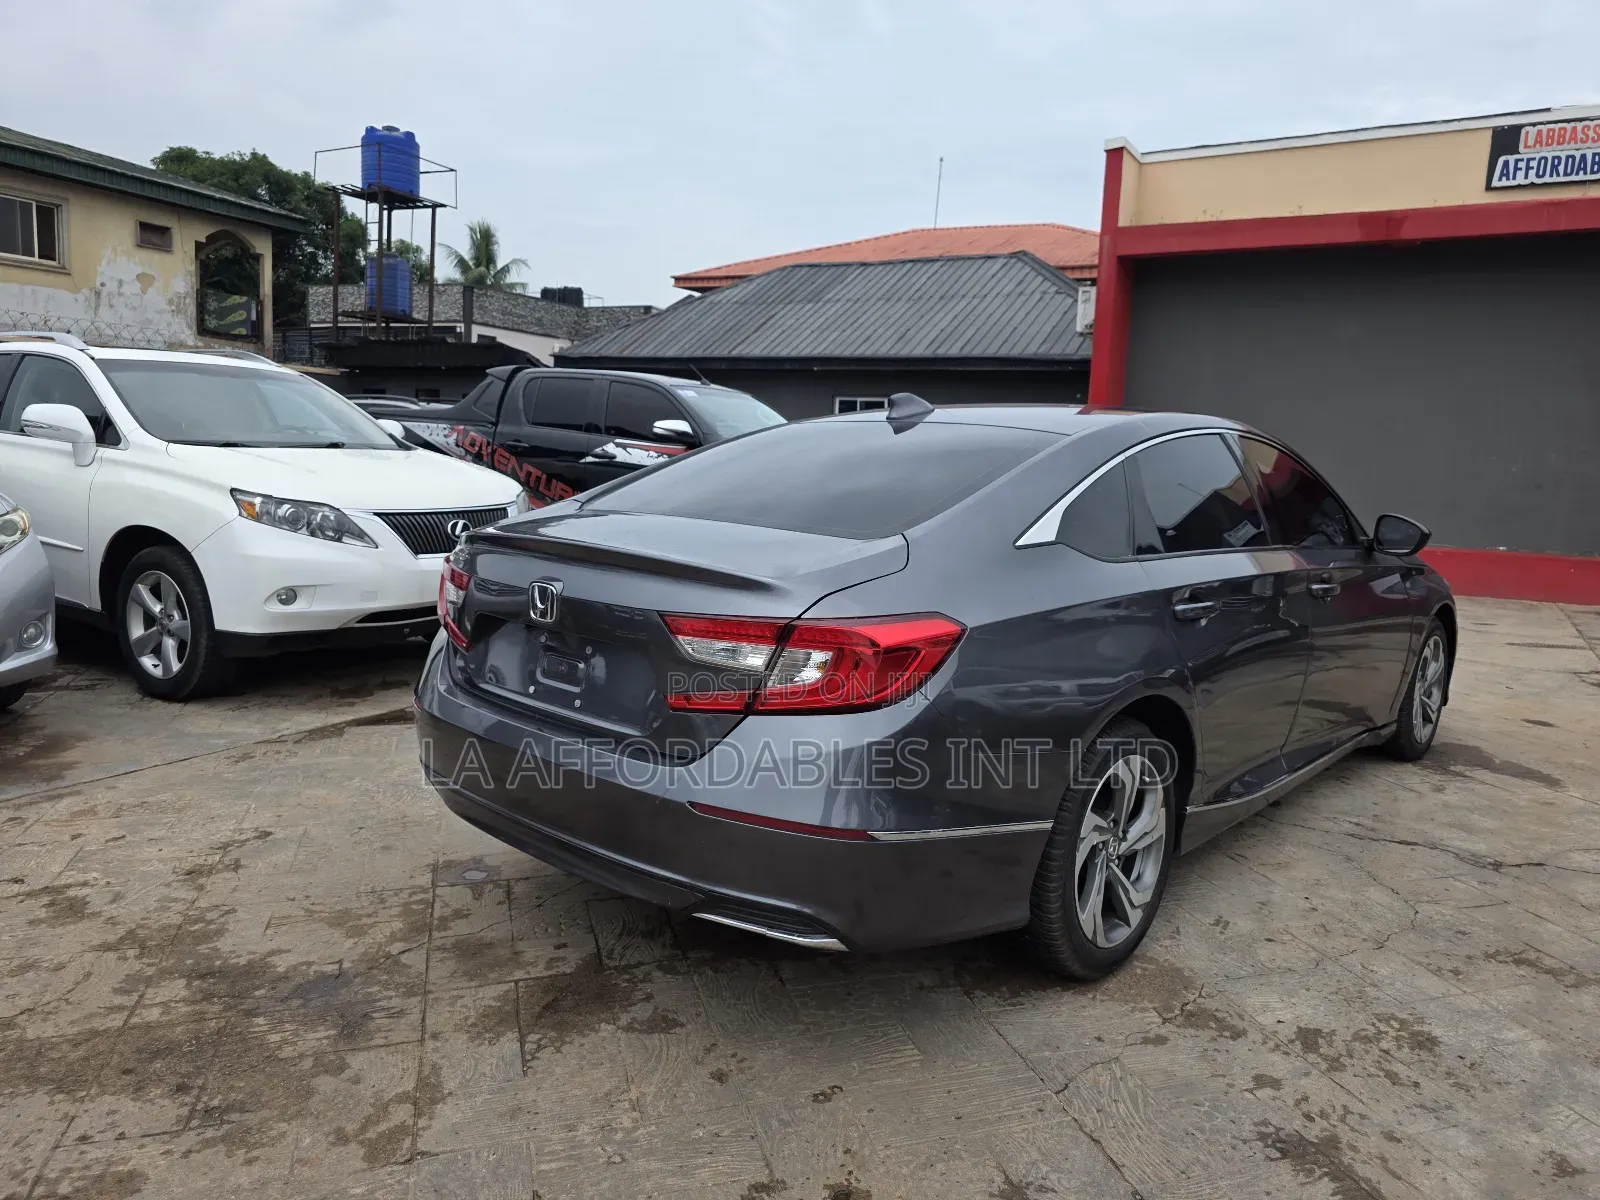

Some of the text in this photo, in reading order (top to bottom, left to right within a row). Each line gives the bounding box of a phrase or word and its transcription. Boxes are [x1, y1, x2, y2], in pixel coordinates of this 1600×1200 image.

[1523, 123, 1600, 149] LABBASS
[1498, 152, 1600, 182] AFFORDAB
[447, 424, 580, 501] ADVENTUR
